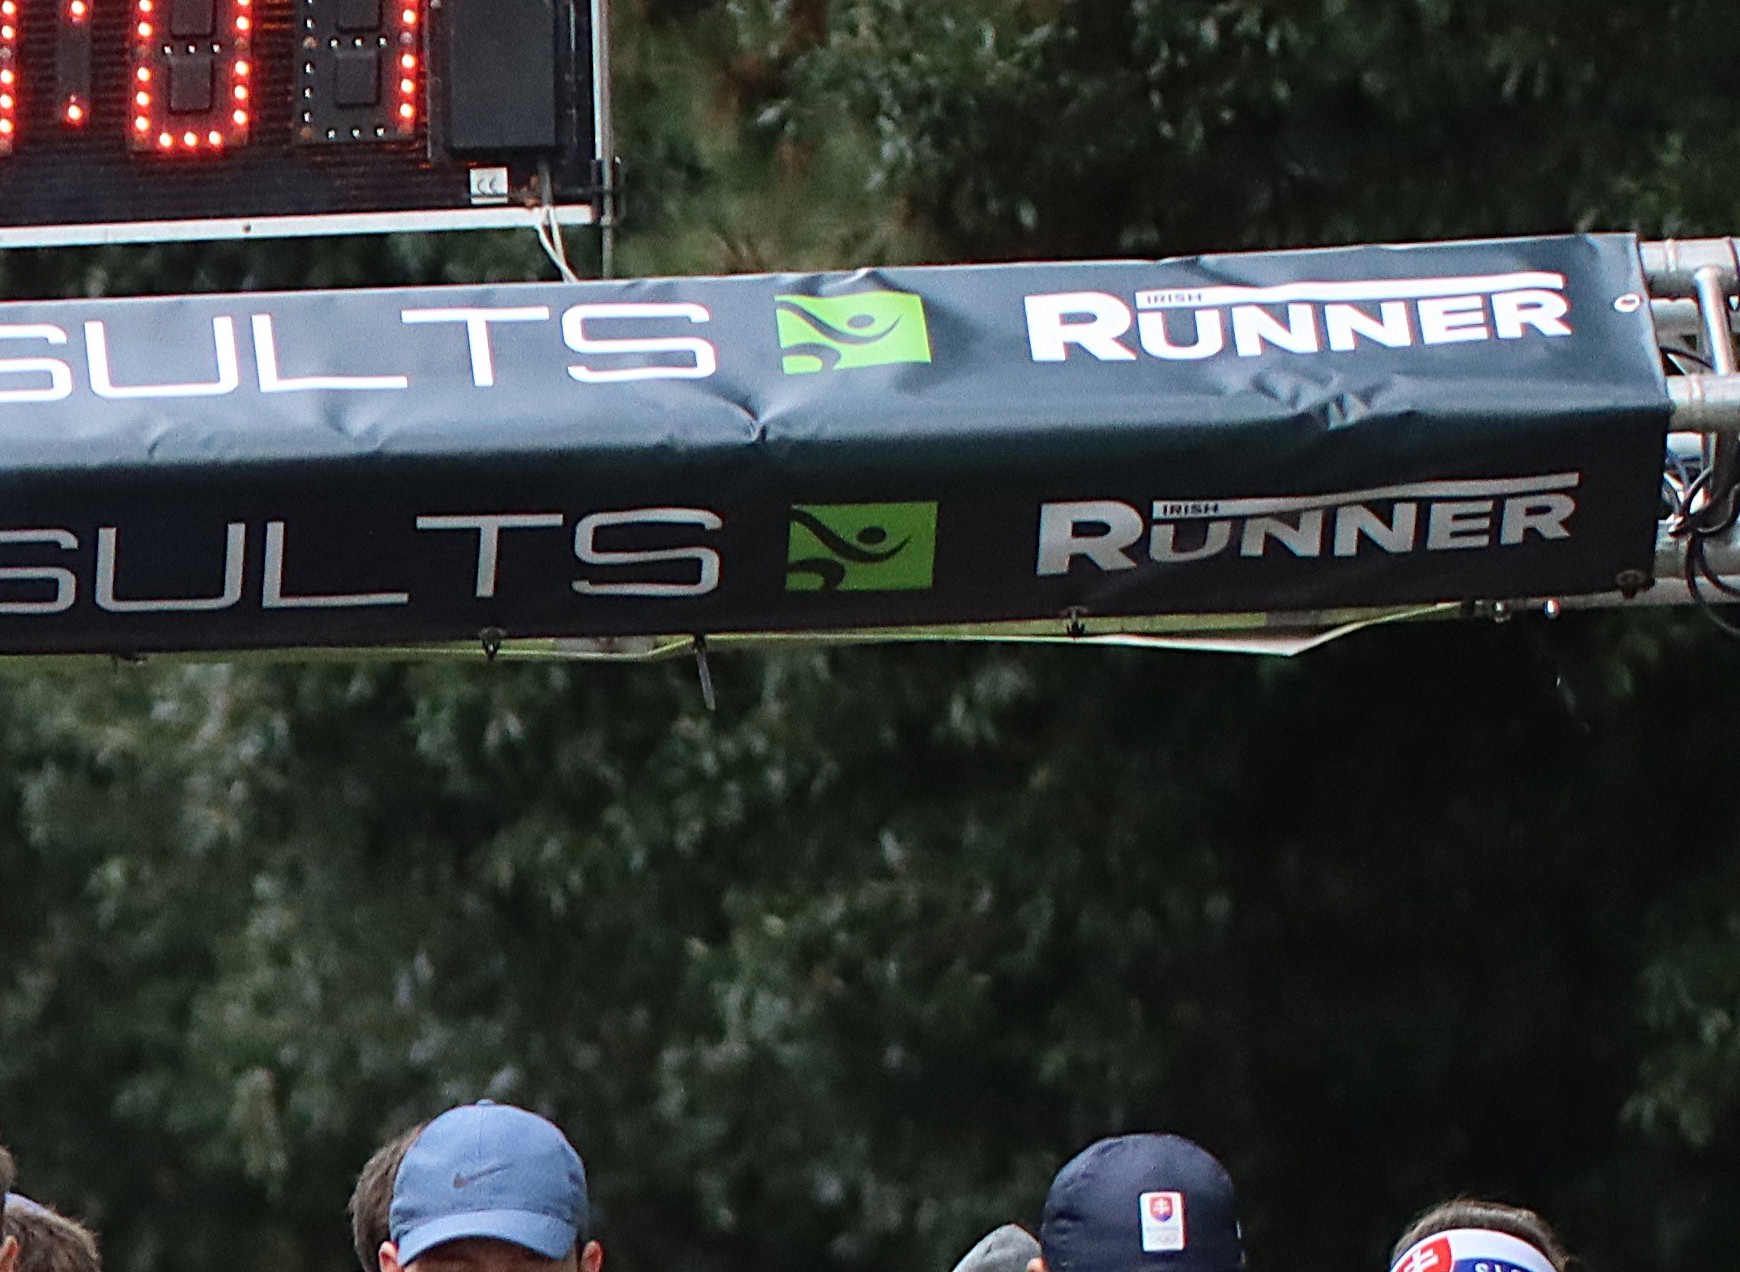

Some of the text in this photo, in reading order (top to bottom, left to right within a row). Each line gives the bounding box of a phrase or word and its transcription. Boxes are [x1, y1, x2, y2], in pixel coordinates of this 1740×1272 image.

[1024, 287, 1571, 364] RUNNER
[1036, 492, 1580, 577] RUNNER
[1161, 501, 1221, 516] IRISH
